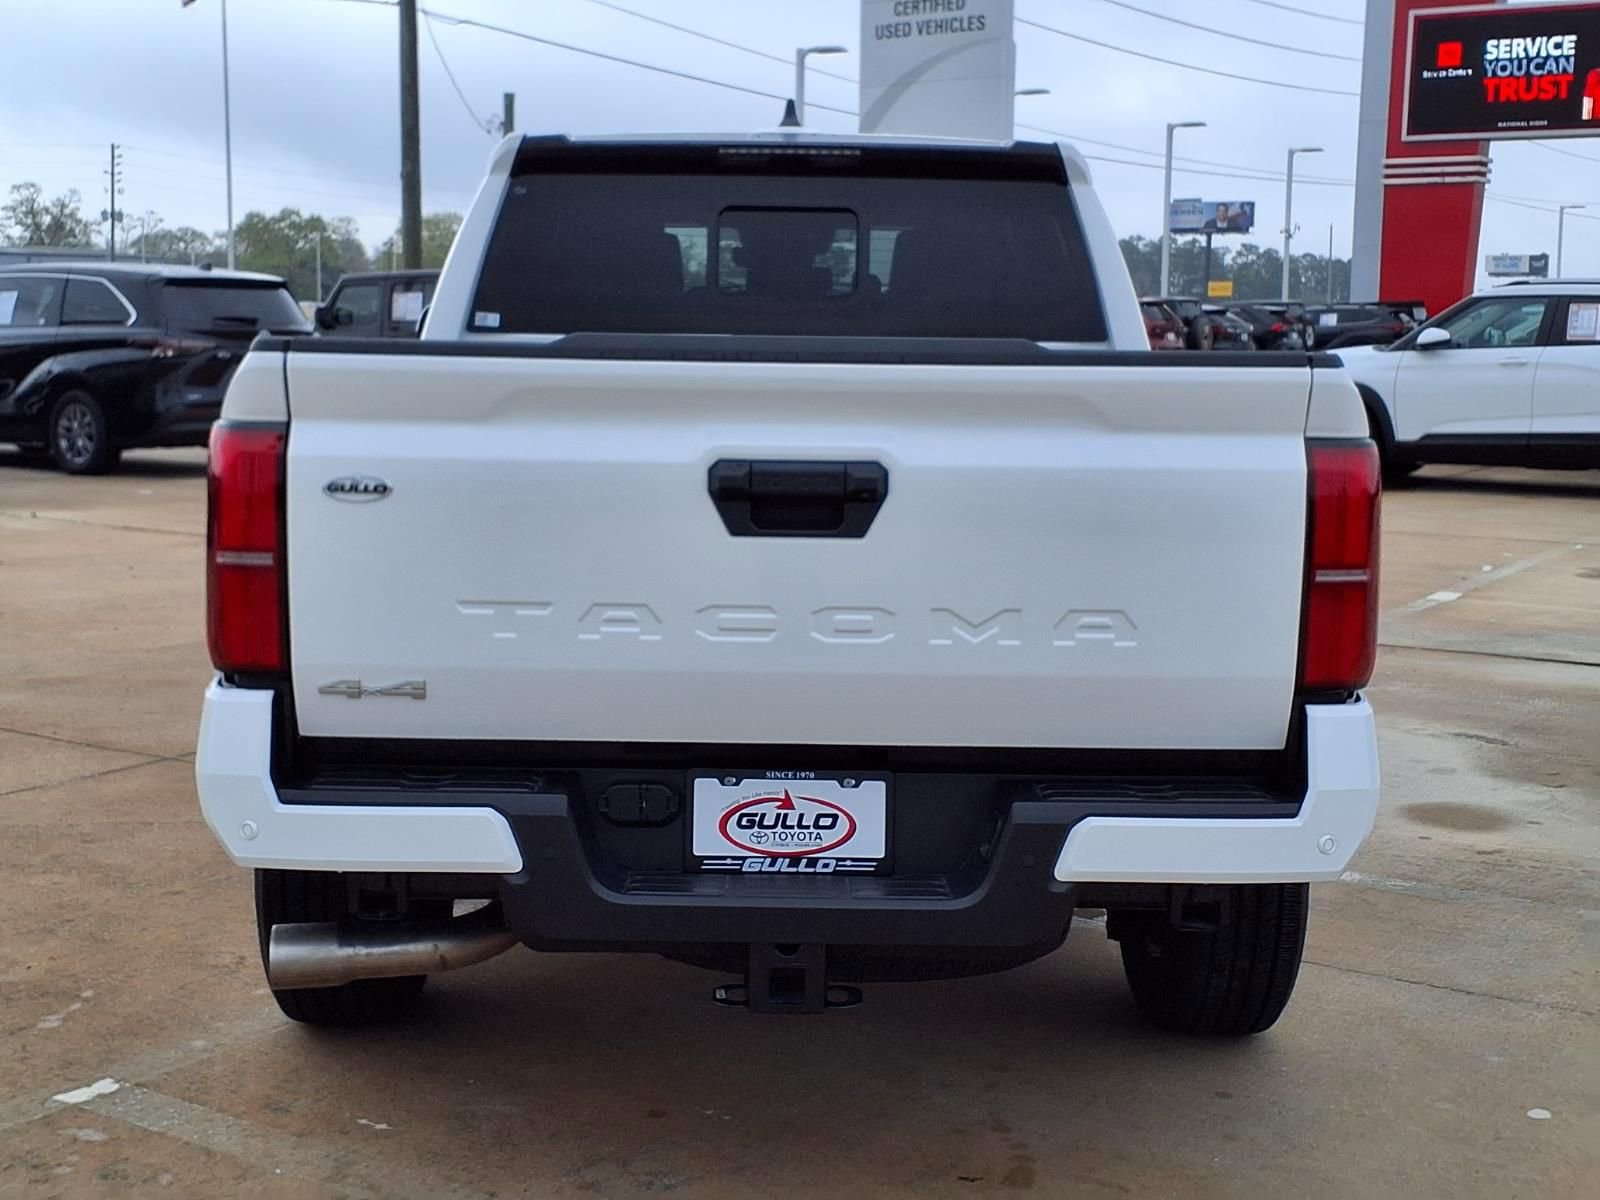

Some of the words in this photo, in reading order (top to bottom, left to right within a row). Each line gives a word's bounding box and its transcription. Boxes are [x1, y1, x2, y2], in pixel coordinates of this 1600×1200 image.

[893, 0, 966, 17] CERTIFIED
[875, 22, 911, 40] USED
[915, 14, 986, 36] VEHICLES
[1485, 35, 1577, 60] SERVICE
[1484, 59, 1527, 77] YOU
[1529, 56, 1574, 76] CAN
[1483, 74, 1575, 103] TRUST
[326, 481, 389, 494] GULLO
[455, 600, 1138, 648] TACOMA
[766, 771, 795, 779] SINCE
[796, 771, 815, 779] 1970
[736, 812, 840, 830] GULLO
[771, 831, 823, 842] TOYOTA
[742, 857, 837, 873] GULLO
